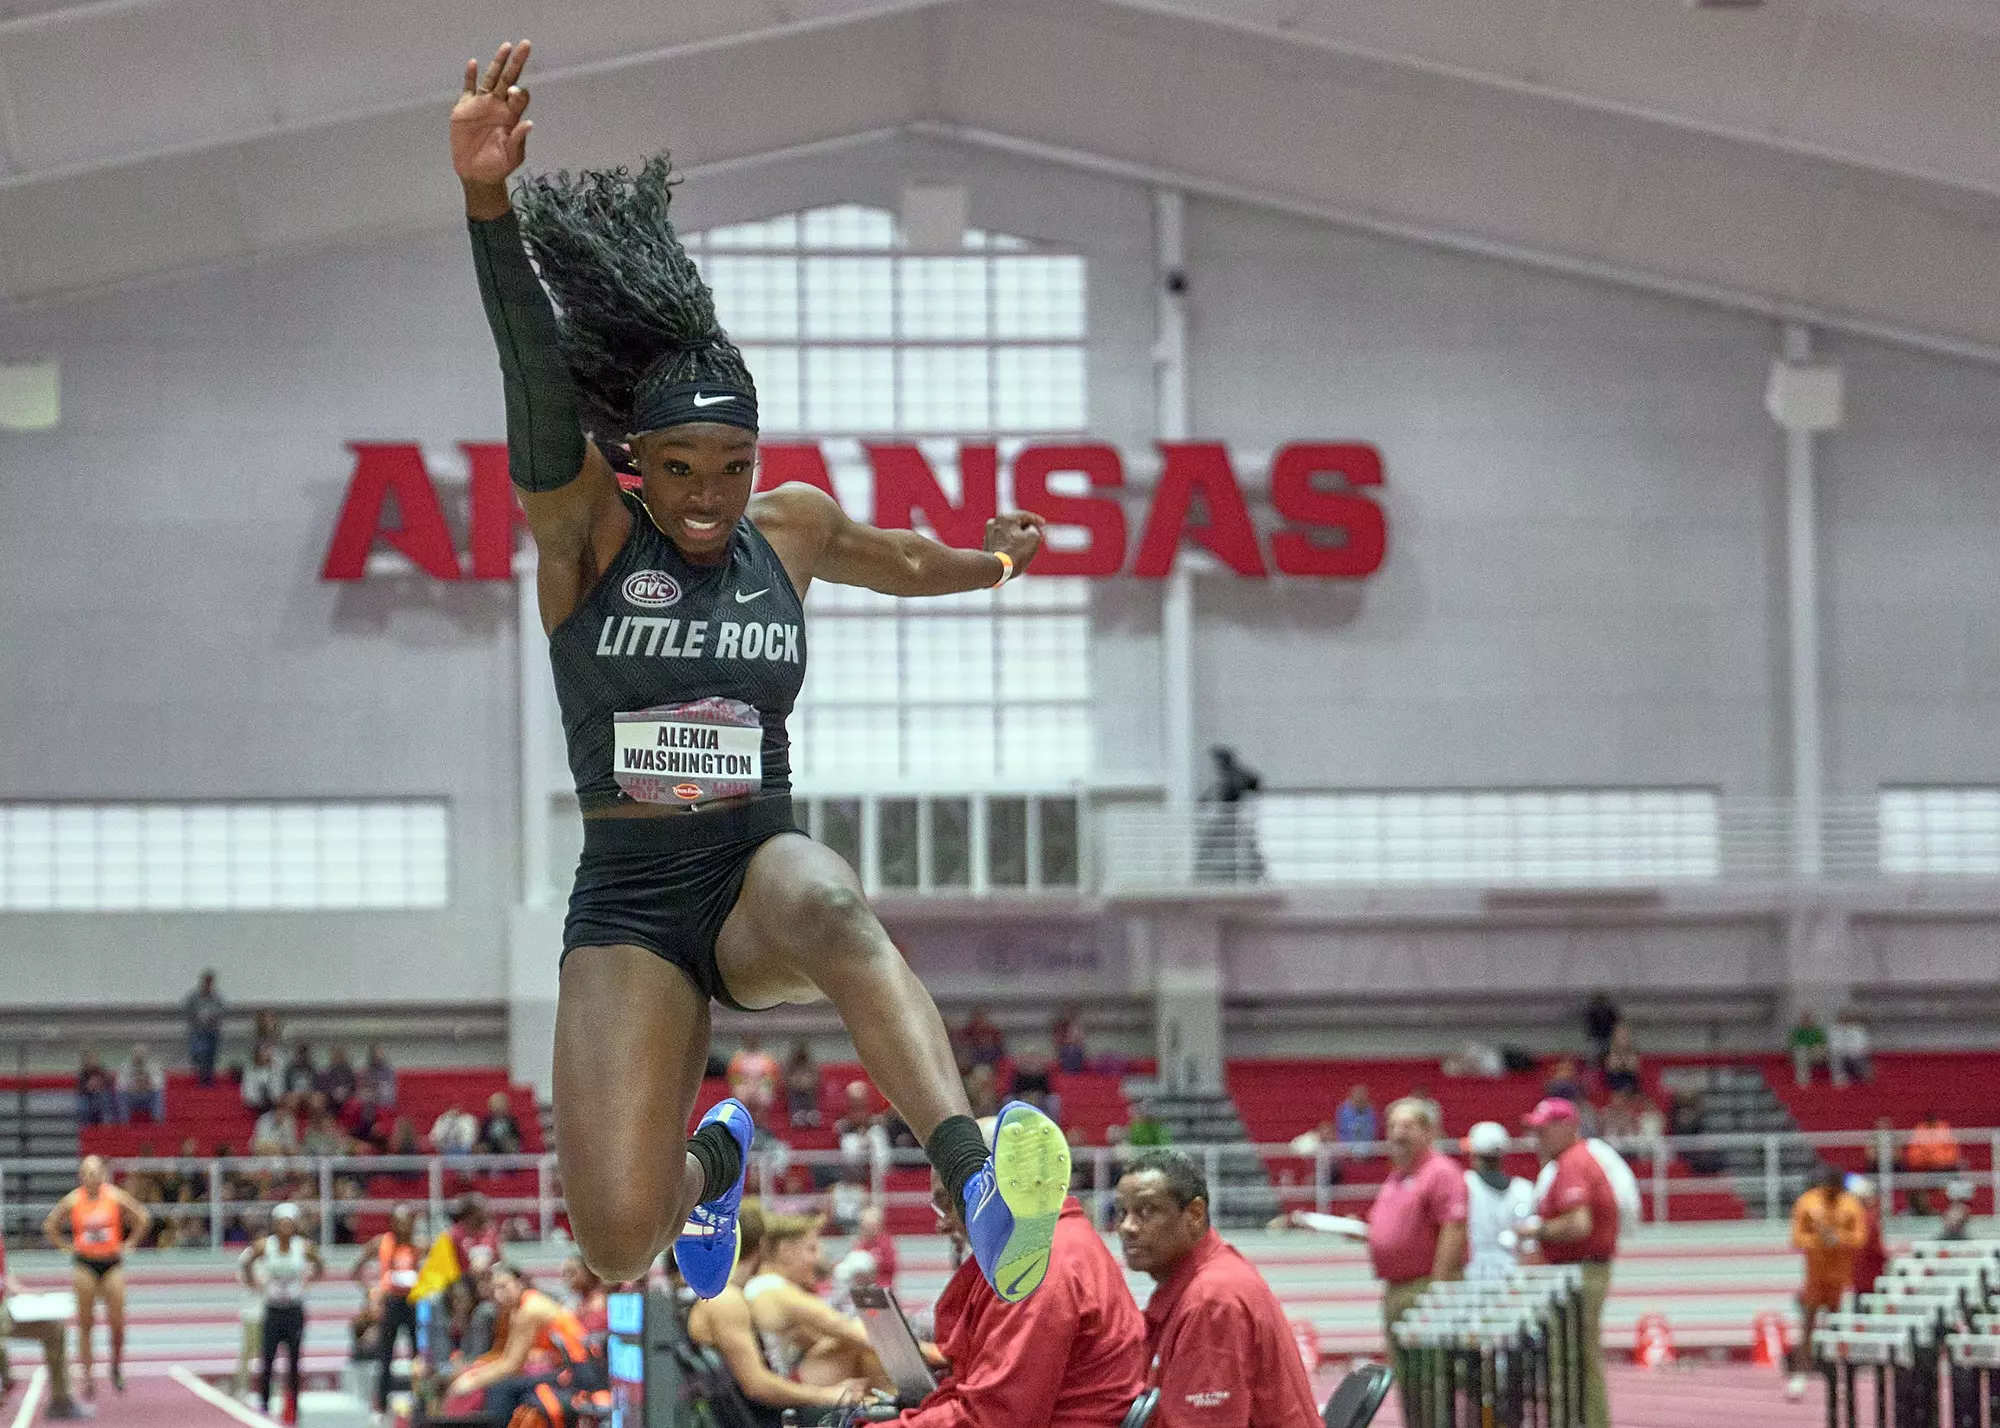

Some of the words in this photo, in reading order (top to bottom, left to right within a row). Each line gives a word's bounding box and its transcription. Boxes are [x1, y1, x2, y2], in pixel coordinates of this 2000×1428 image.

[633, 581, 670, 597] OVC
[596, 616, 708, 658] LITTLE
[715, 622, 799, 664] ROCK
[657, 726, 719, 750] ALEXIA
[623, 748, 752, 775] WASHINGTON
